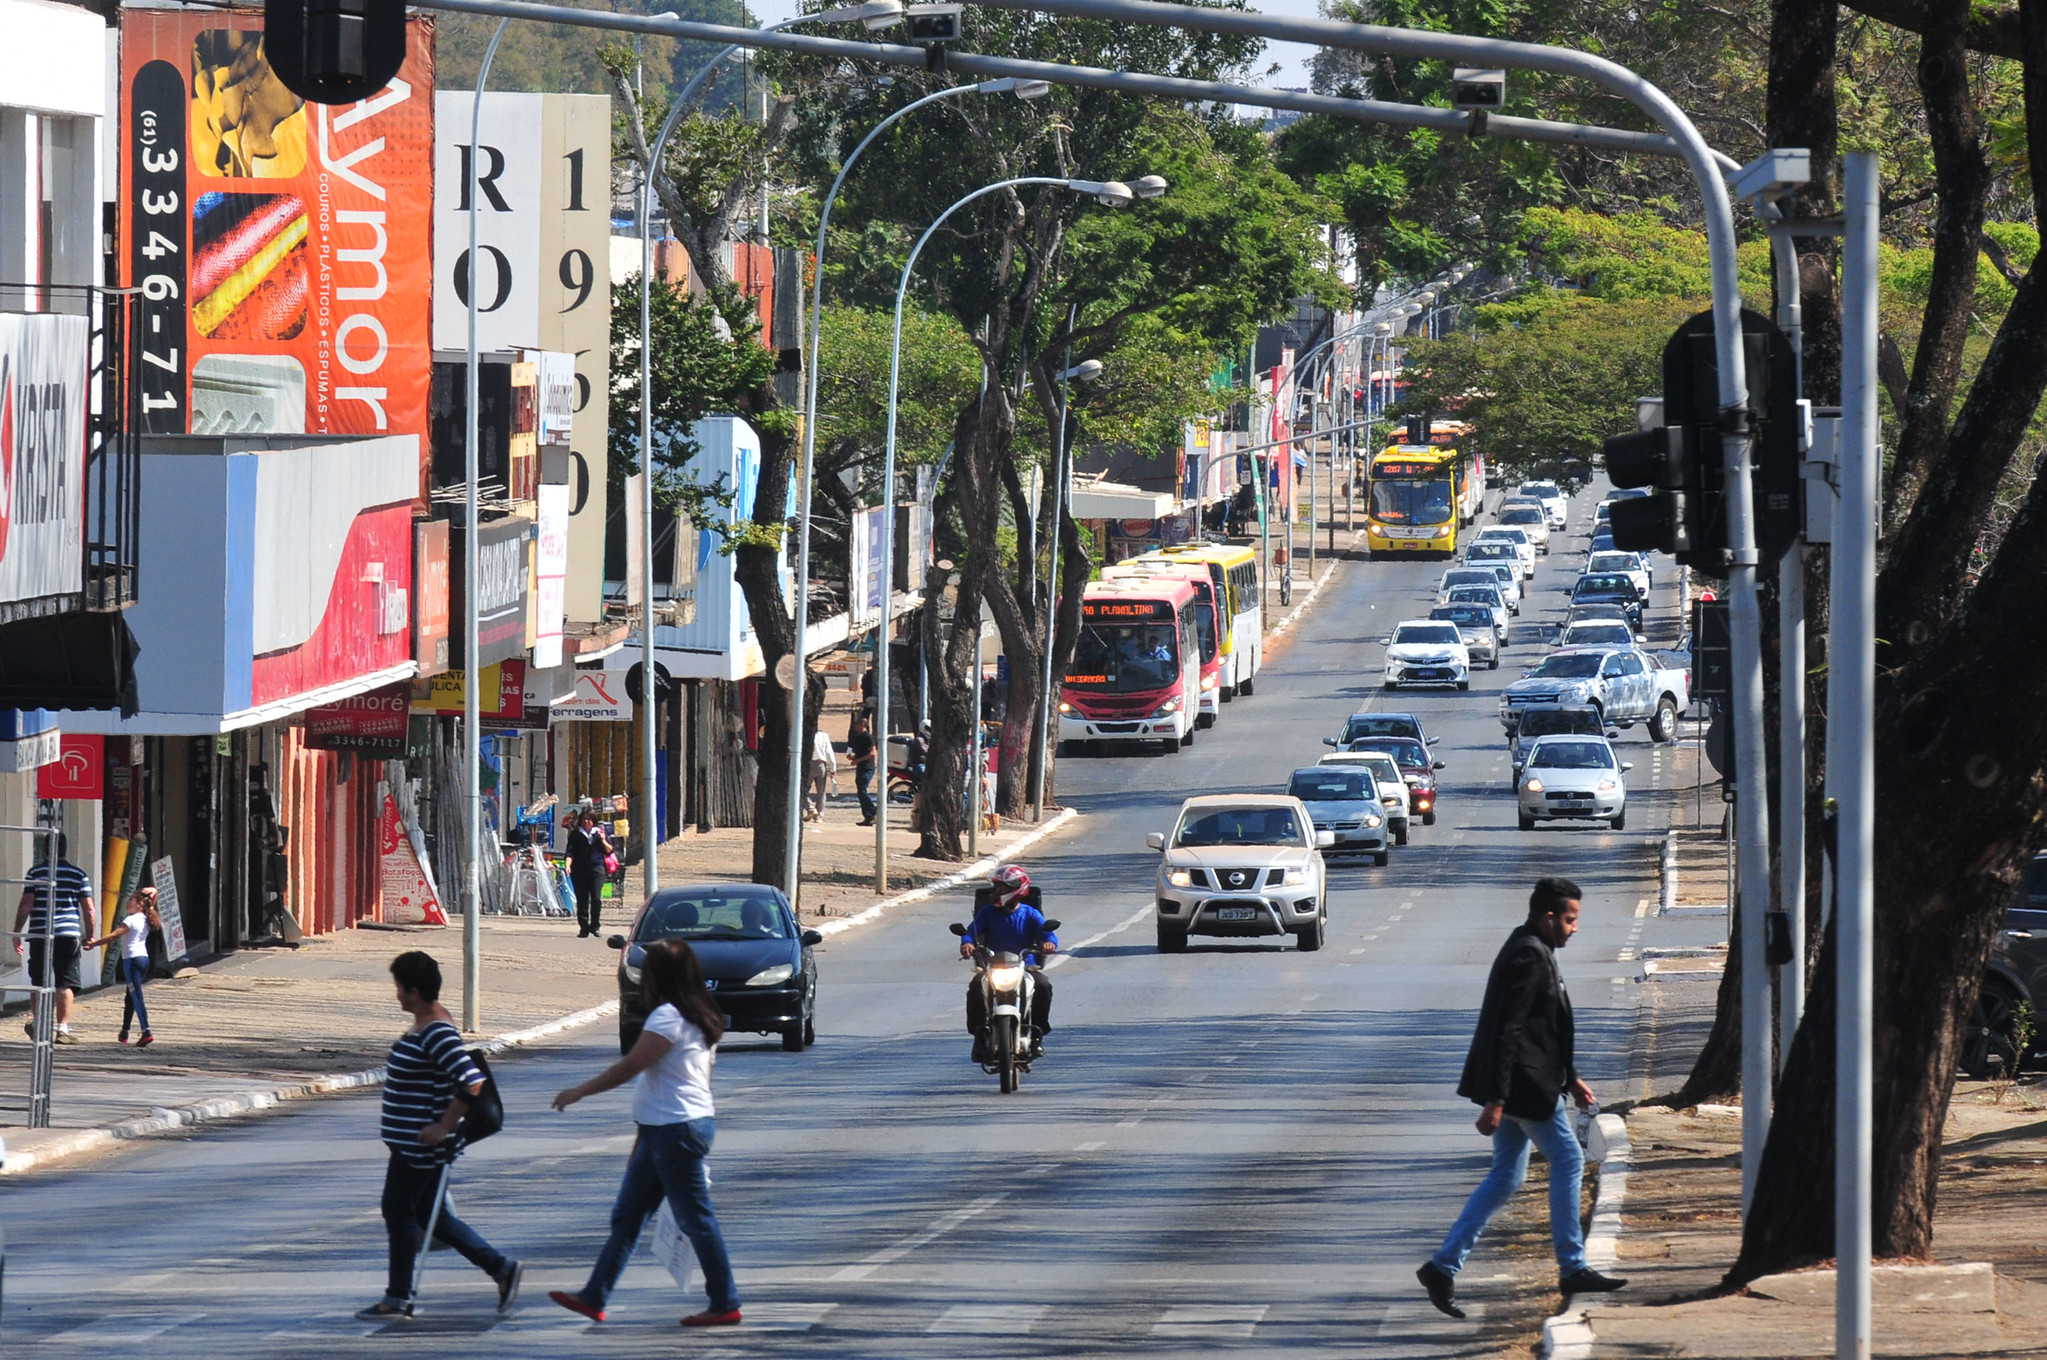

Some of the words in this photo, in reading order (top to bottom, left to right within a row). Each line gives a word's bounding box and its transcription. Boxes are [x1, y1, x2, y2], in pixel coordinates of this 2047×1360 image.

[140, 109, 157, 145] (61)
[318, 172, 329, 232] COUROS
[319, 244, 331, 327] PLÁSTICOS
[318, 340, 329, 413] ESPUMAS
[1101, 604, 1154, 616] PLANALTINA
[322, 693, 404, 711] ymoré
[550, 708, 618, 718] erragens
[334, 736, 400, 748] 3346-7117
